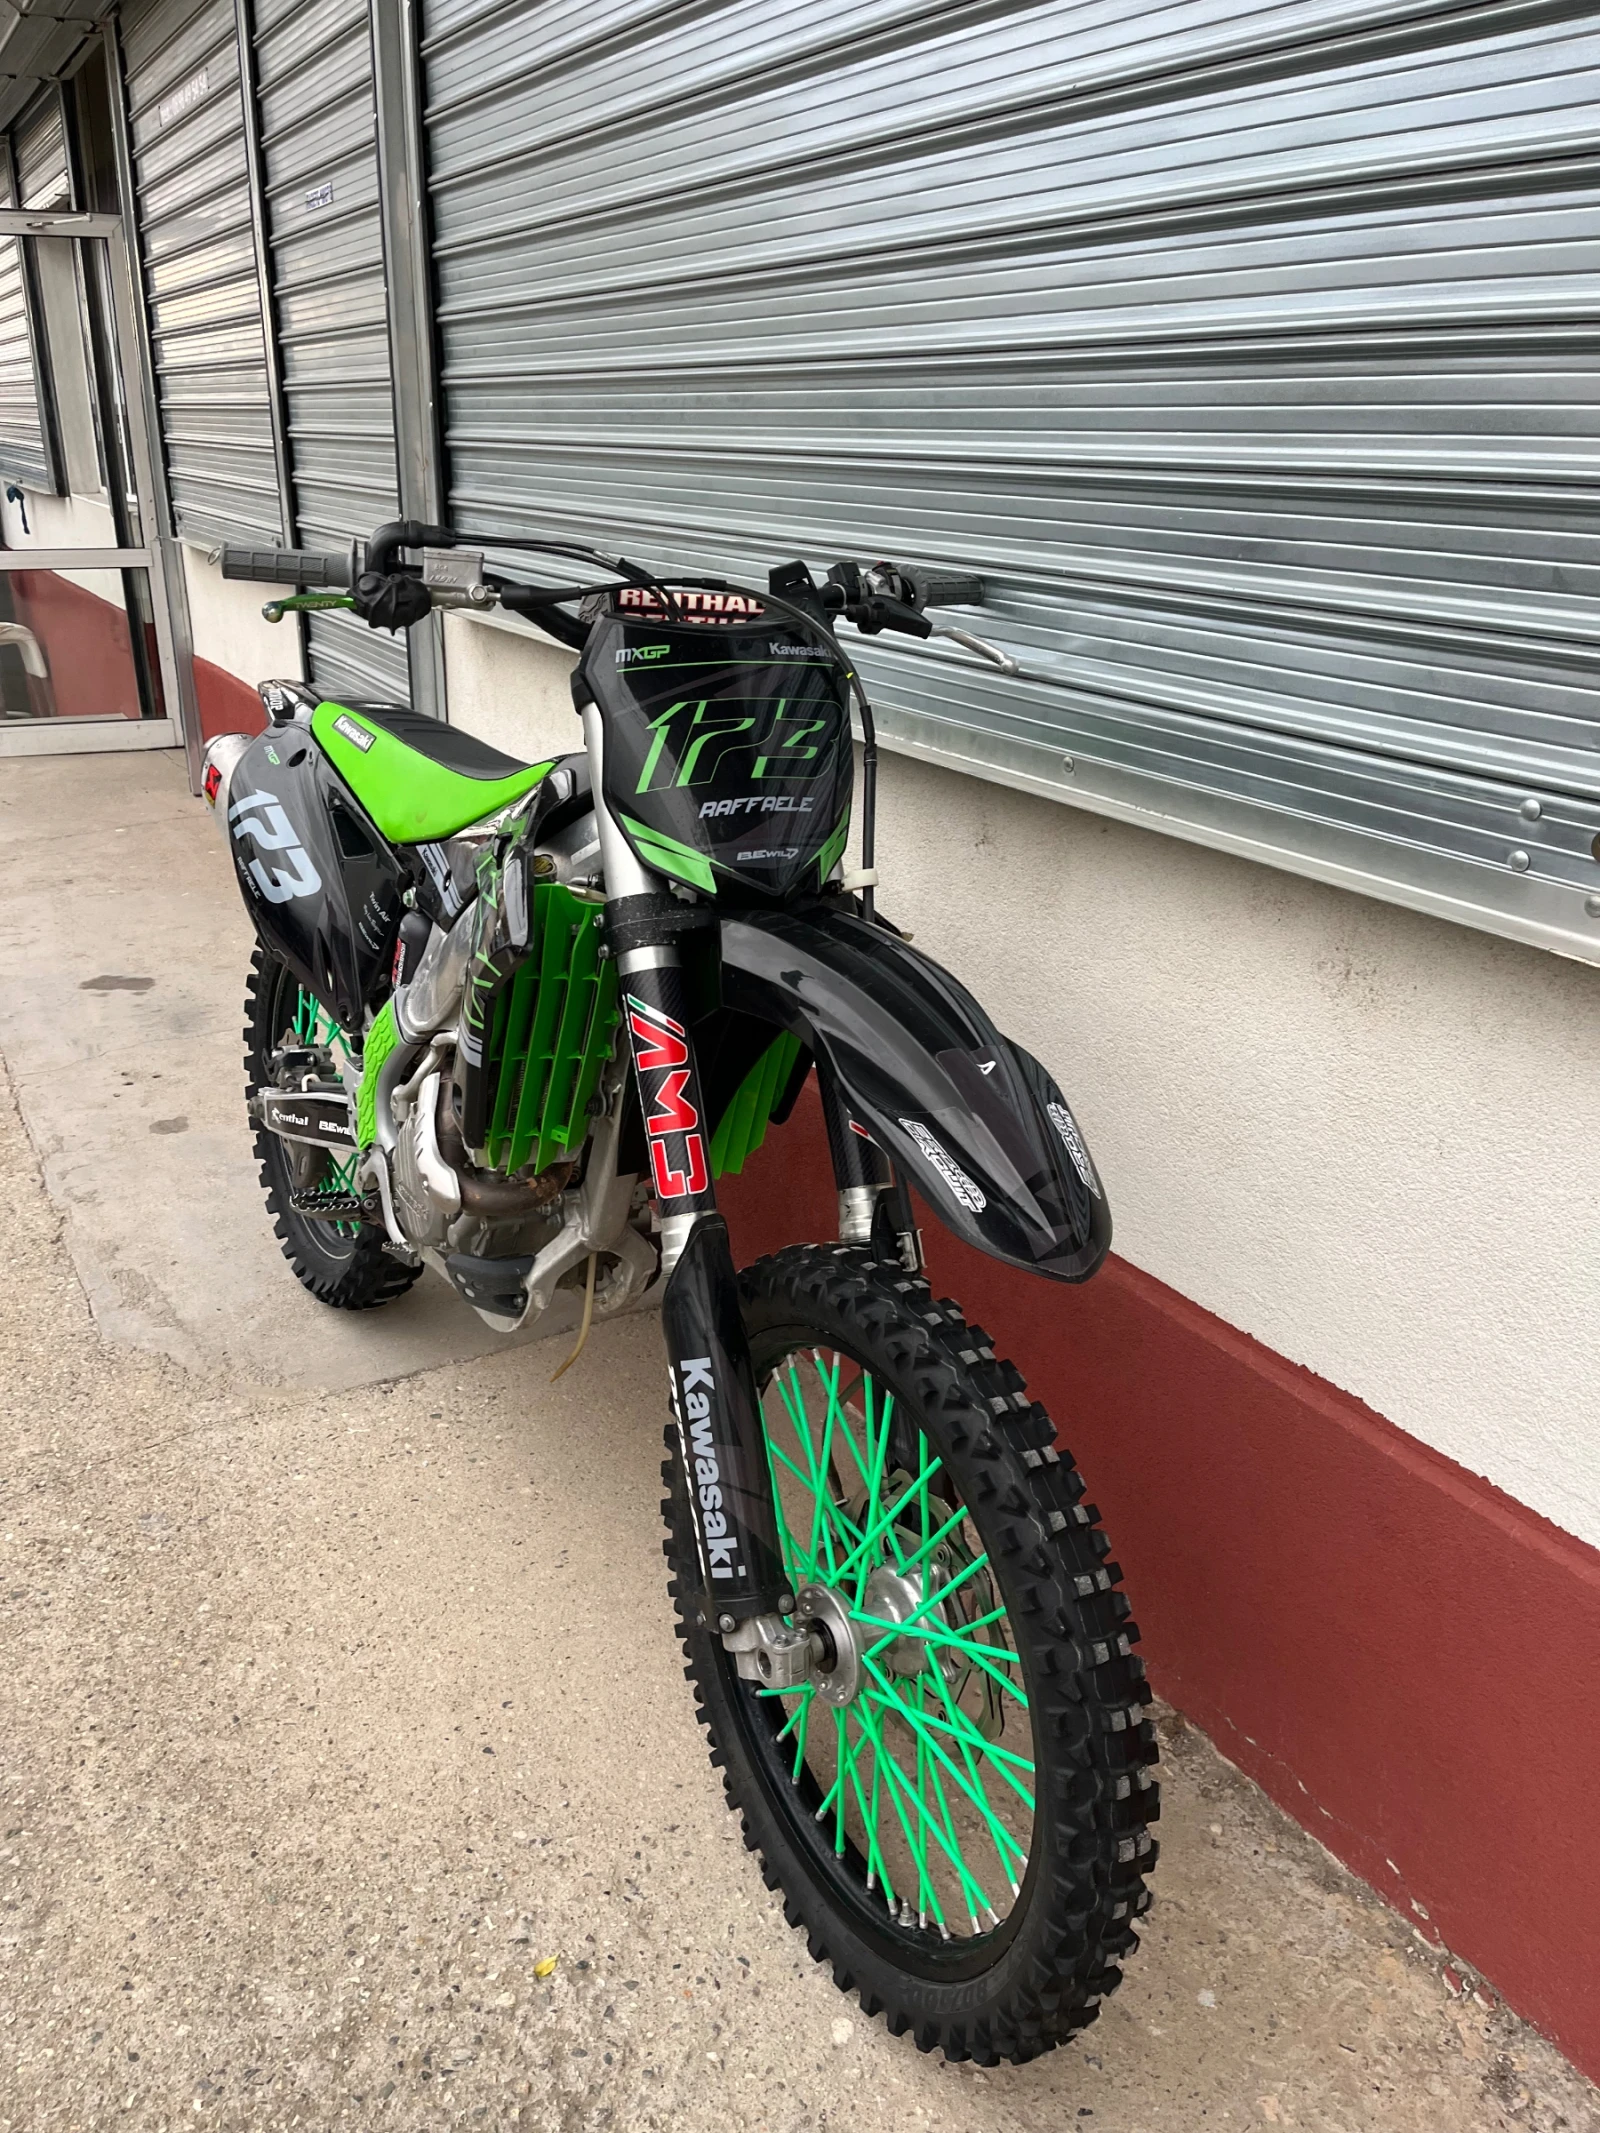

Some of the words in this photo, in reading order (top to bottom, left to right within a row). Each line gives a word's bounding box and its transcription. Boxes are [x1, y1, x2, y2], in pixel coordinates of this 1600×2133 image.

[615, 645, 670, 663] MXGP
[334, 715, 374, 749] Kawasaki
[698, 797, 815, 819] RAFFAELE
[369, 890, 381, 912] Twin
[379, 910, 391, 923] Air
[271, 1106, 309, 1126] Renthal
[318, 1120, 352, 1136] BEWIL
[680, 1357, 747, 1579] Kawasaki
